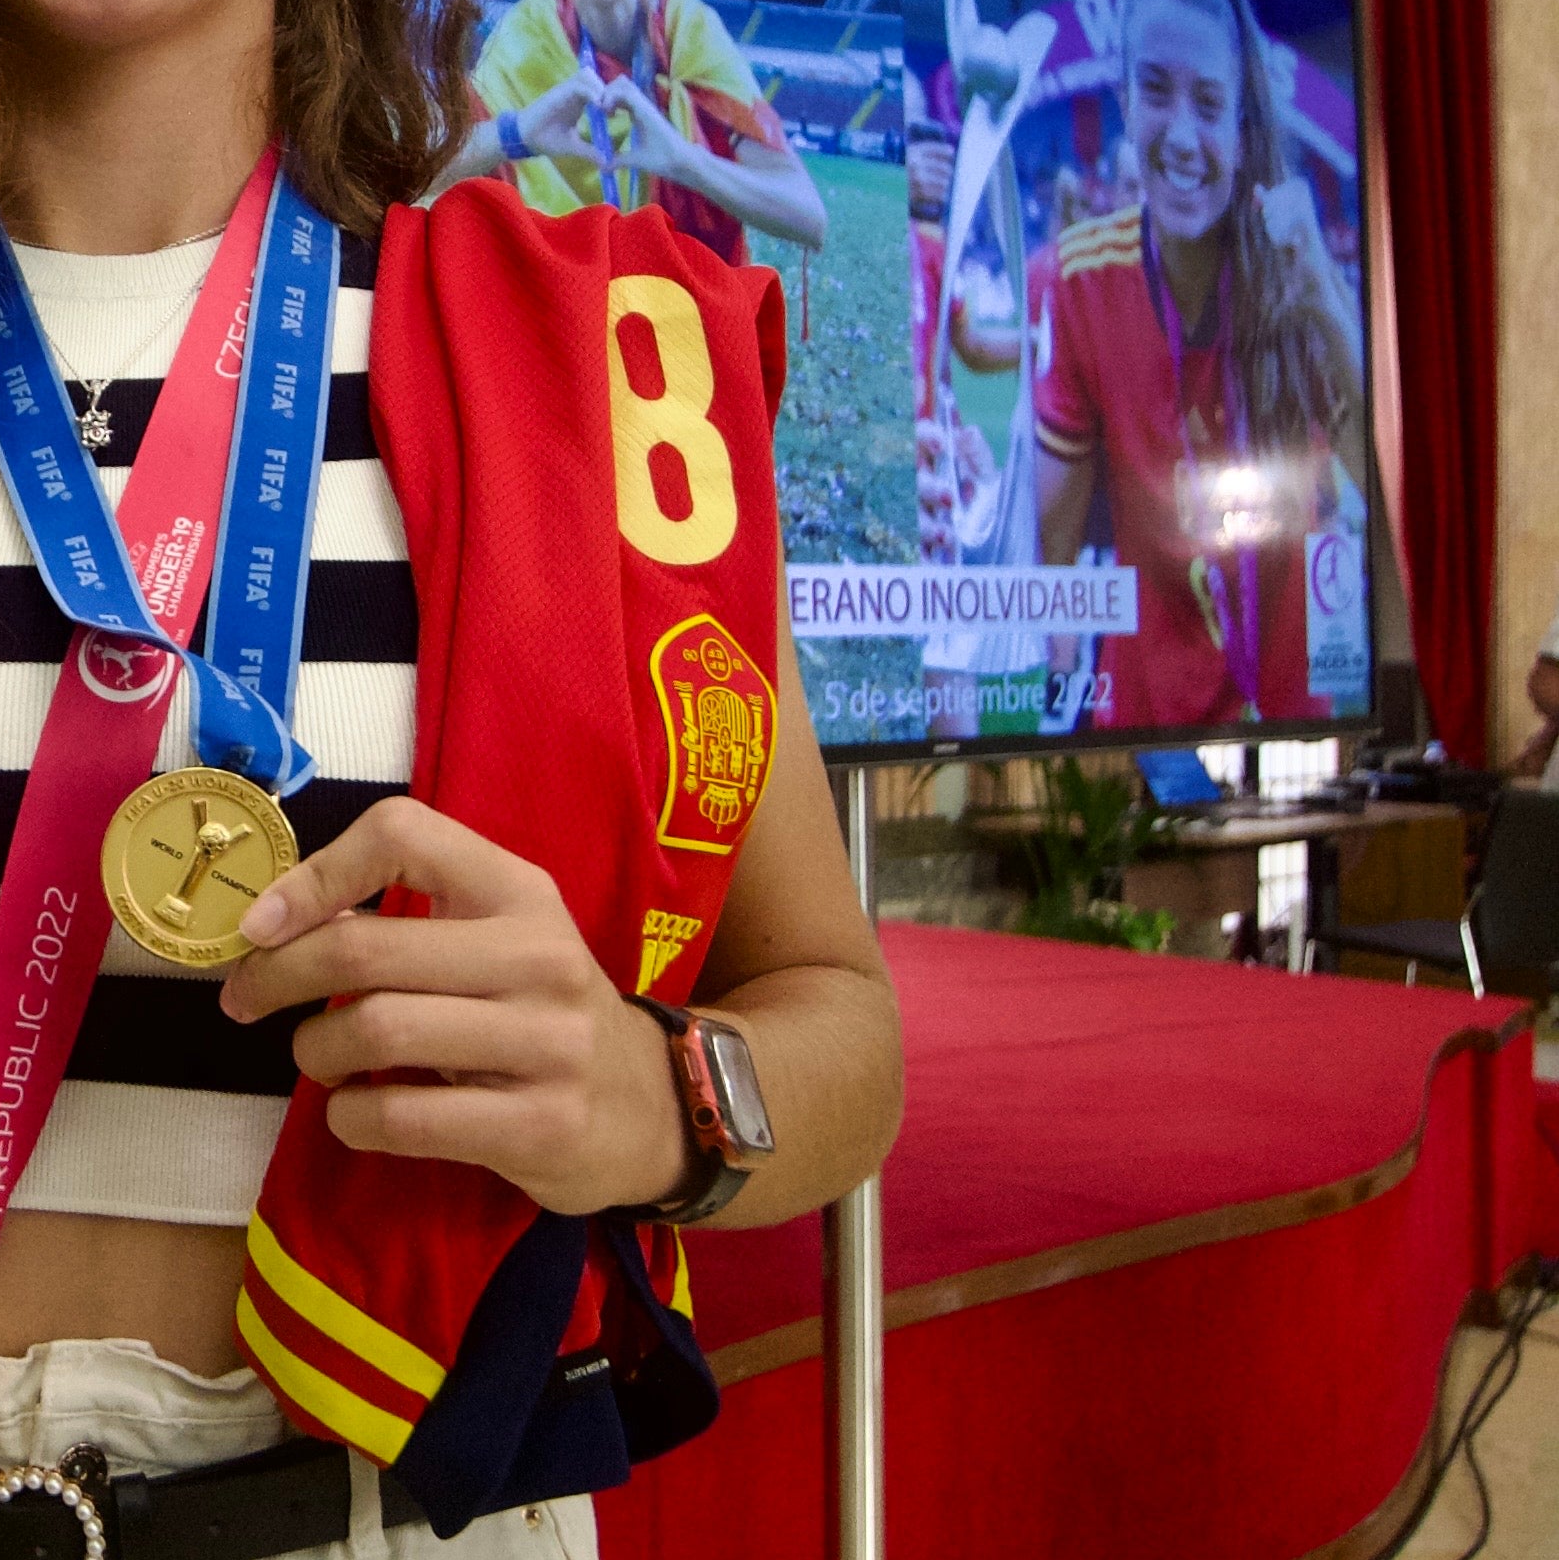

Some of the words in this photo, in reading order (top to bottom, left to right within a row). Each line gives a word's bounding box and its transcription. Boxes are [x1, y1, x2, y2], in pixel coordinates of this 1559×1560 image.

[606, 275, 738, 566] 8
[141, 532, 169, 591] WOMEN'S
[149, 516, 195, 616] UNDER-19
[164, 519, 205, 619] CHAMPIONSHIP
[790, 578, 911, 623] ERANO
[921, 578, 1122, 623] INOLVIDABLE
[824, 680, 841, 720] 5
[849, 678, 884, 719] de
[893, 677, 1046, 723] septiembre
[1051, 672, 1113, 711] 222
[150, 838, 183, 861] WORLD
[25, 886, 78, 984] 2022
